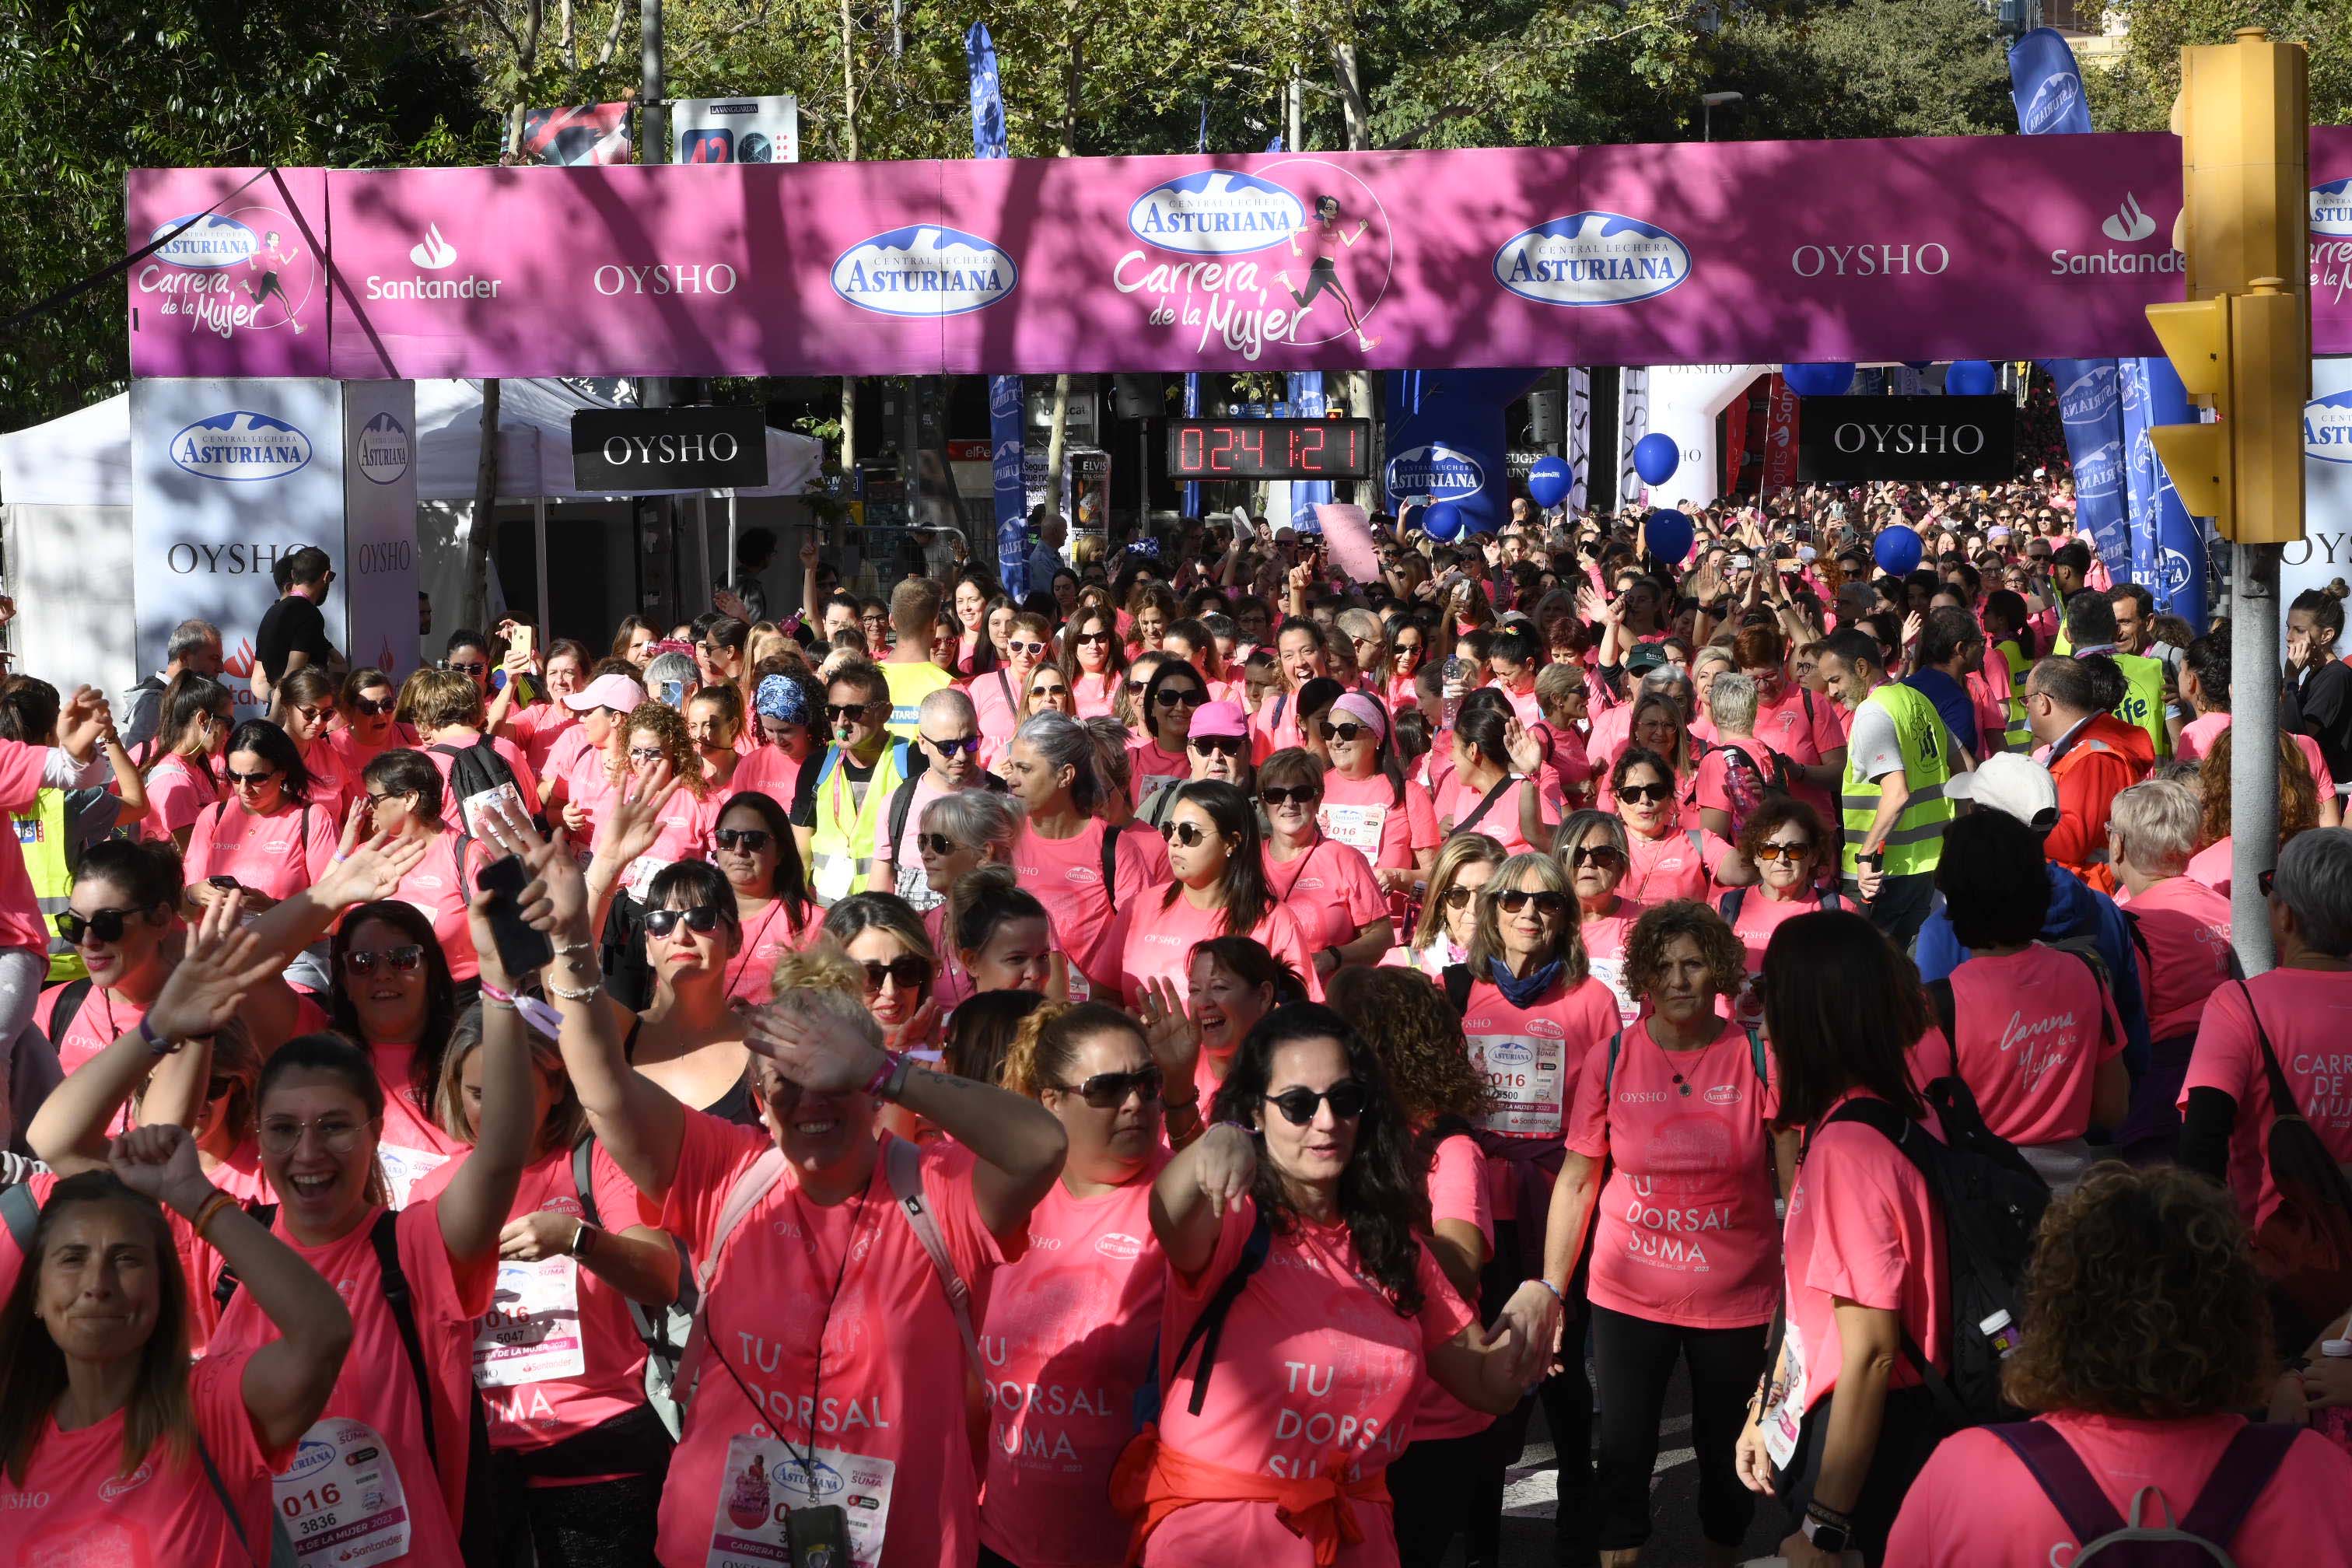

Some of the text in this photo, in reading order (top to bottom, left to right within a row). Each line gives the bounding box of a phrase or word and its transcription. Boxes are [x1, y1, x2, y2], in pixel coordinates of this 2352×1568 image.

[1142, 201, 1292, 233] ASTURIANA
[157, 233, 250, 254] ASTURIANA
[1538, 243, 1669, 255] CENTRAL LECHERA
[874, 257, 933, 266] CENTRAL
[1113, 250, 1259, 294] Carrera
[1508, 248, 1676, 283] ASTURIANA
[1792, 242, 1950, 277] OYSHO
[2051, 248, 2187, 275] Santande
[138, 264, 229, 293] Carrera
[366, 275, 502, 301] Santander
[593, 264, 737, 296] OYSHO
[845, 259, 1004, 292] ASTURIANA
[161, 291, 264, 339] de la Mujer
[1150, 288, 1314, 362] de la Mujer
[180, 437, 303, 464] ASTURIANA
[604, 432, 738, 465] OYSHO
[1834, 422, 1985, 455] OYSHO
[361, 439, 407, 467] ASTURIANA
[1390, 468, 1478, 490] ASTURIANA
[359, 540, 411, 575] OYSHO
[1332, 826, 1356, 835] 016
[68, 1034, 107, 1051] OYSH
[2000, 1010, 2077, 1052] Carrera
[1493, 1051, 1530, 1061] ASTURIANA
[2018, 1041, 2068, 1094] Mujer
[1492, 1073, 1526, 1087] 016
[1620, 1091, 1668, 1104] OYSHO
[1519, 1117, 1552, 1125] Santander
[1626, 1200, 1734, 1233] DORSAL
[1628, 1230, 1707, 1263] SUMA
[538, 1268, 566, 1277] SUMA
[485, 1306, 530, 1328] 016
[496, 1331, 525, 1344] 5047
[498, 1349, 509, 1357] DE
[510, 1347, 522, 1356] LA
[523, 1344, 549, 1355] MUJER
[531, 1358, 572, 1372] Santander
[739, 1331, 782, 1373] TU
[1285, 1360, 1335, 1398] TU
[286, 1451, 332, 1472] URIANA
[851, 1475, 882, 1488] SUMA
[282, 1482, 341, 1517] 016
[300, 1513, 337, 1535] 3836
[306, 1515, 394, 1552] DE LA MUJER 2023
[352, 1533, 404, 1558] Santander
[730, 1541, 775, 1557] CARRERA
